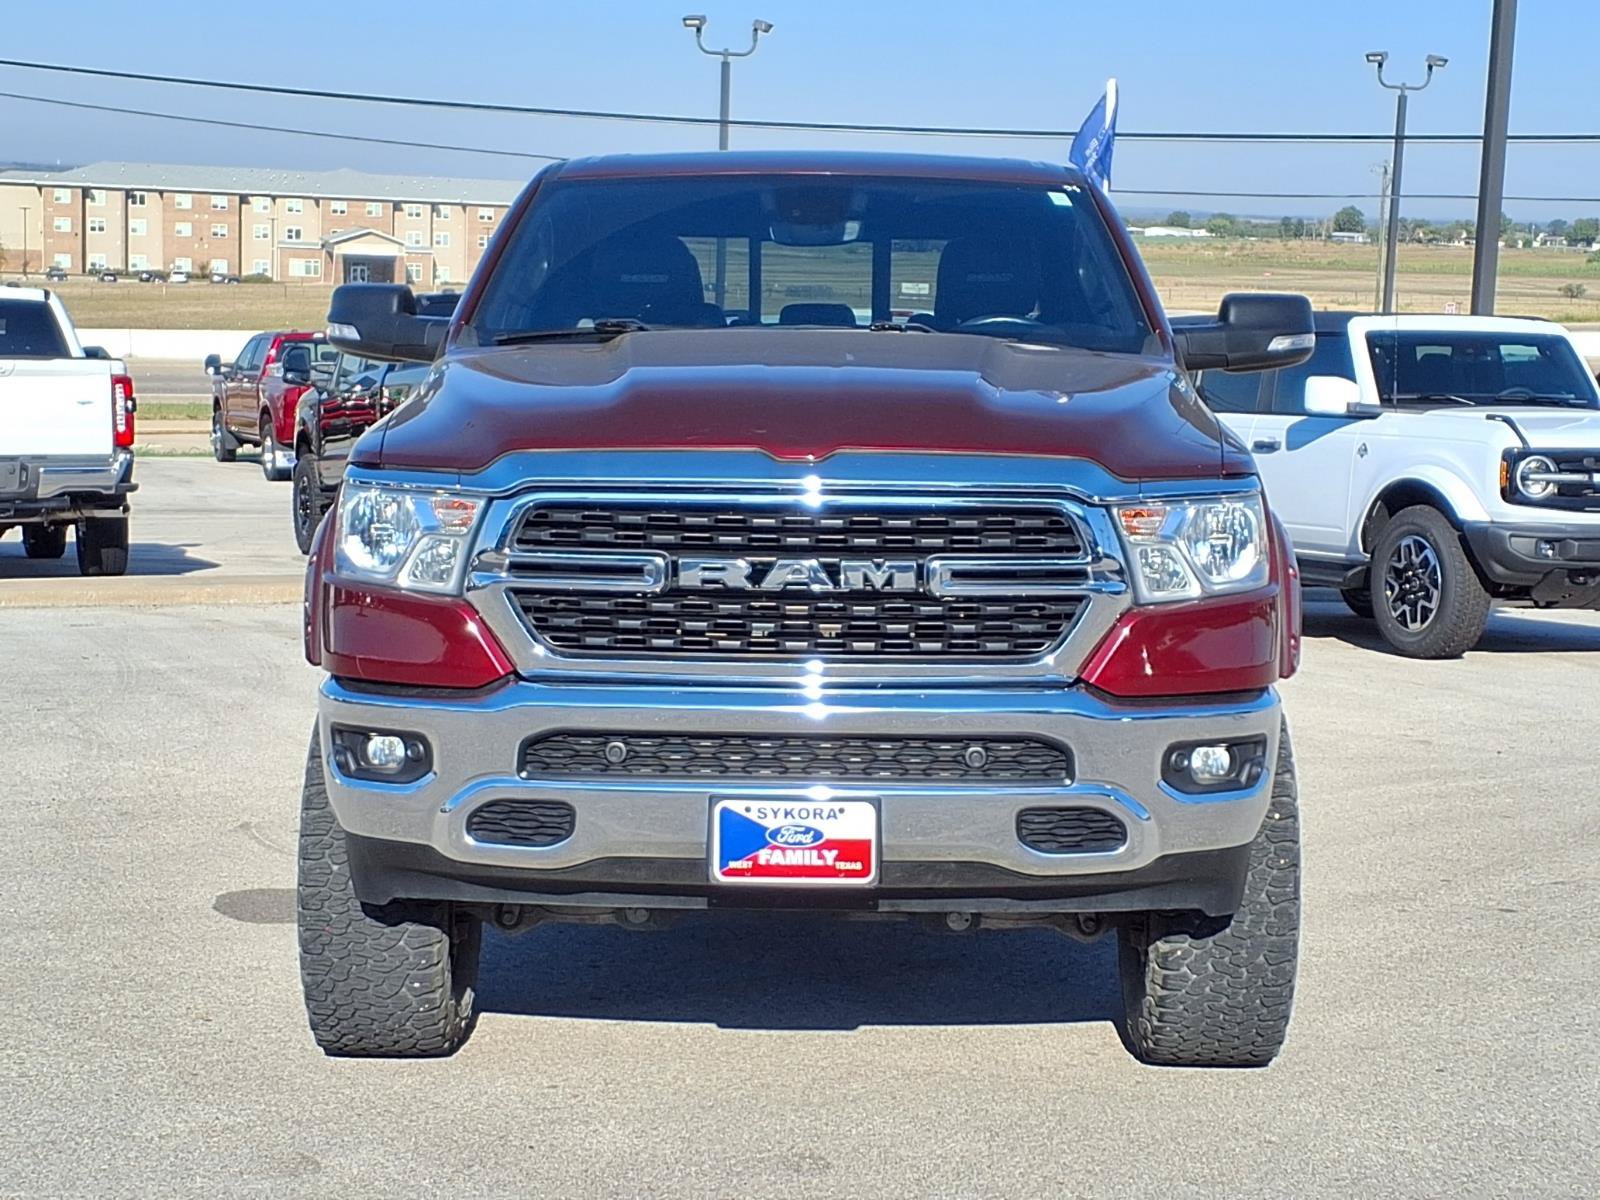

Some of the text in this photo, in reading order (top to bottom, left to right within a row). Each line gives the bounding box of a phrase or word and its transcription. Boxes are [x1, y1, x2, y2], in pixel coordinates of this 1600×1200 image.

[678, 558, 917, 592] RAM
[757, 807, 838, 820] SYKORA
[777, 825, 814, 844] Ford
[757, 849, 839, 866] FAMILY
